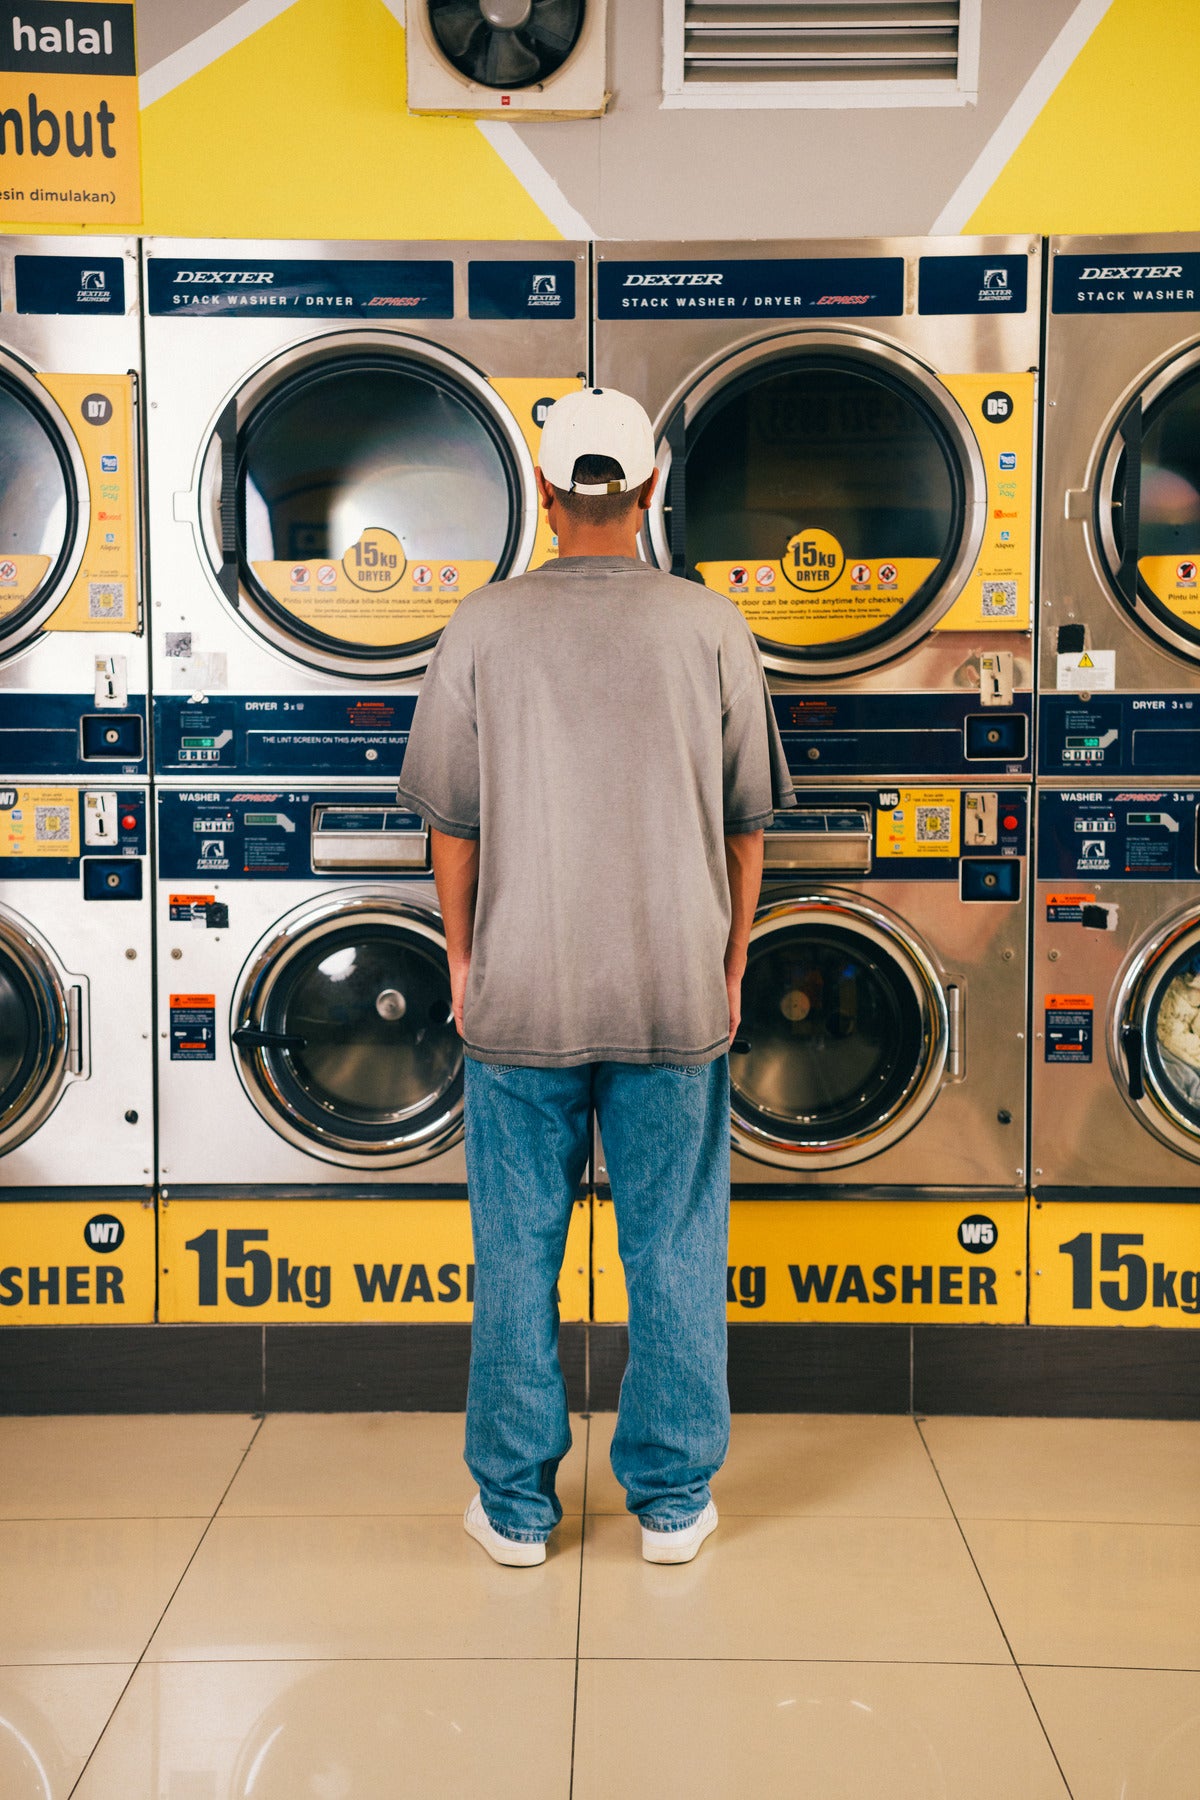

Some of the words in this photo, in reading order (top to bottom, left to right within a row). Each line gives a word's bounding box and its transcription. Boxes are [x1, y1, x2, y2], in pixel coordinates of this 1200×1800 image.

[12, 16, 113, 55] halal
[30, 188, 116, 205] dimulakan)
[172, 271, 274, 284] DEXTER
[1078, 265, 1183, 280] DEXTER
[623, 273, 724, 286] DEXTER
[172, 295, 220, 305] STACK
[227, 295, 287, 306] WASHER
[306, 296, 353, 306] DRYER
[366, 296, 422, 306] EXPRESS
[815, 295, 870, 305] EXPRESS
[1077, 291, 1125, 301] STACK
[1133, 289, 1194, 299] WASHER
[622, 298, 669, 307] STACK
[676, 297, 735, 307] WASHER
[754, 296, 802, 306] DRYER
[87, 401, 106, 418] D7
[987, 398, 1009, 416] D5
[536, 405, 548, 422] D
[351, 542, 397, 568] 15kg
[791, 541, 836, 569] 15kg
[358, 570, 391, 582] DRYER
[796, 570, 830, 582] DRYER
[790, 598, 820, 606] opened
[822, 598, 853, 606] anytime
[868, 596, 904, 604] checking
[245, 702, 278, 711] DRYER
[283, 702, 289, 711] 3
[1132, 701, 1165, 709] DRYER
[1172, 701, 1178, 709] 3
[262, 736, 276, 744] THE
[277, 736, 291, 744] LINT
[293, 736, 321, 744] SCREEN
[322, 736, 333, 744] ON
[334, 736, 349, 744] THIS
[350, 736, 388, 744] APPLIANCE
[178, 793, 220, 802] WASHER
[288, 794, 295, 802] 3
[879, 793, 899, 806] W5
[1060, 793, 1103, 801] WASHER
[1173, 793, 1179, 801] 3
[89, 1223, 119, 1243] W7
[961, 1223, 994, 1244] W5
[0, 1266, 125, 1306] SHER
[788, 1264, 998, 1305] WASHER
